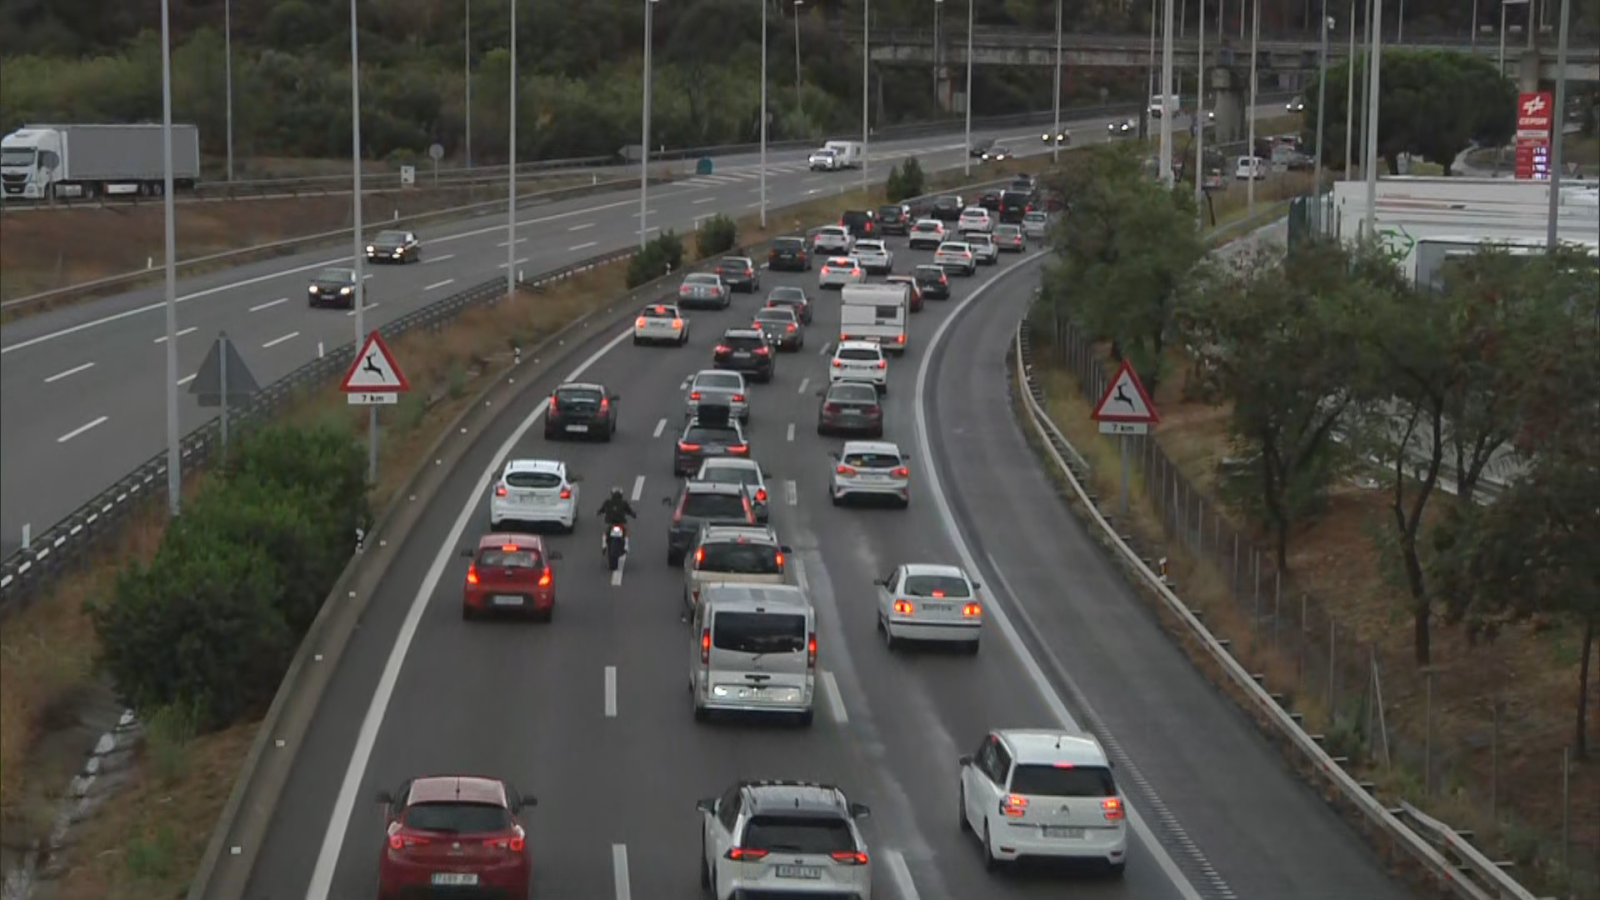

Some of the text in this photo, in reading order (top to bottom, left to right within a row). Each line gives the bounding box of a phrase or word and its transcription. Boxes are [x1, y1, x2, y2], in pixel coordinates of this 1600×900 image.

[361, 394, 384, 402] 7 km
[1112, 423, 1135, 432] 7 km
